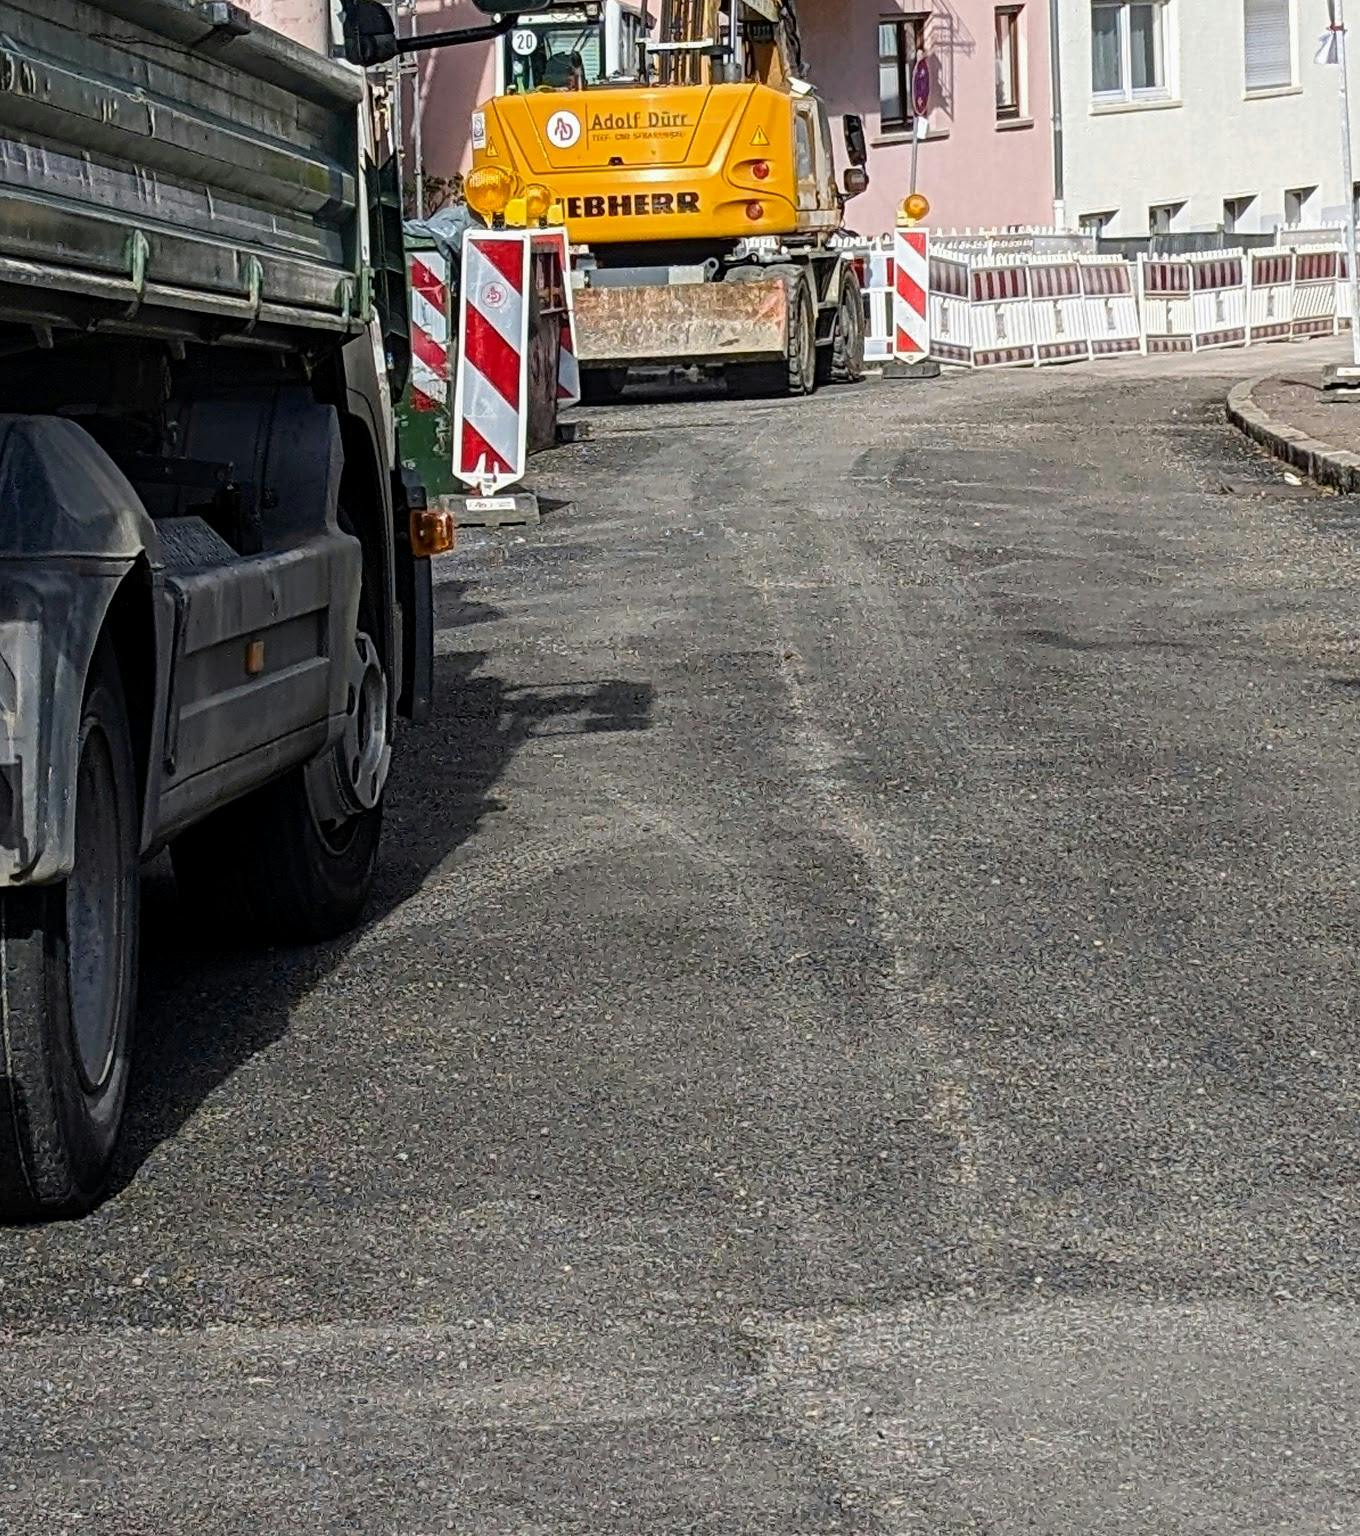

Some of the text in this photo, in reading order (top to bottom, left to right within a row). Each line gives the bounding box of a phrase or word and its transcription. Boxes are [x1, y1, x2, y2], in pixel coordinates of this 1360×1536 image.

[516, 33, 533, 50] 20
[591, 111, 688, 130] Adolf Dürr
